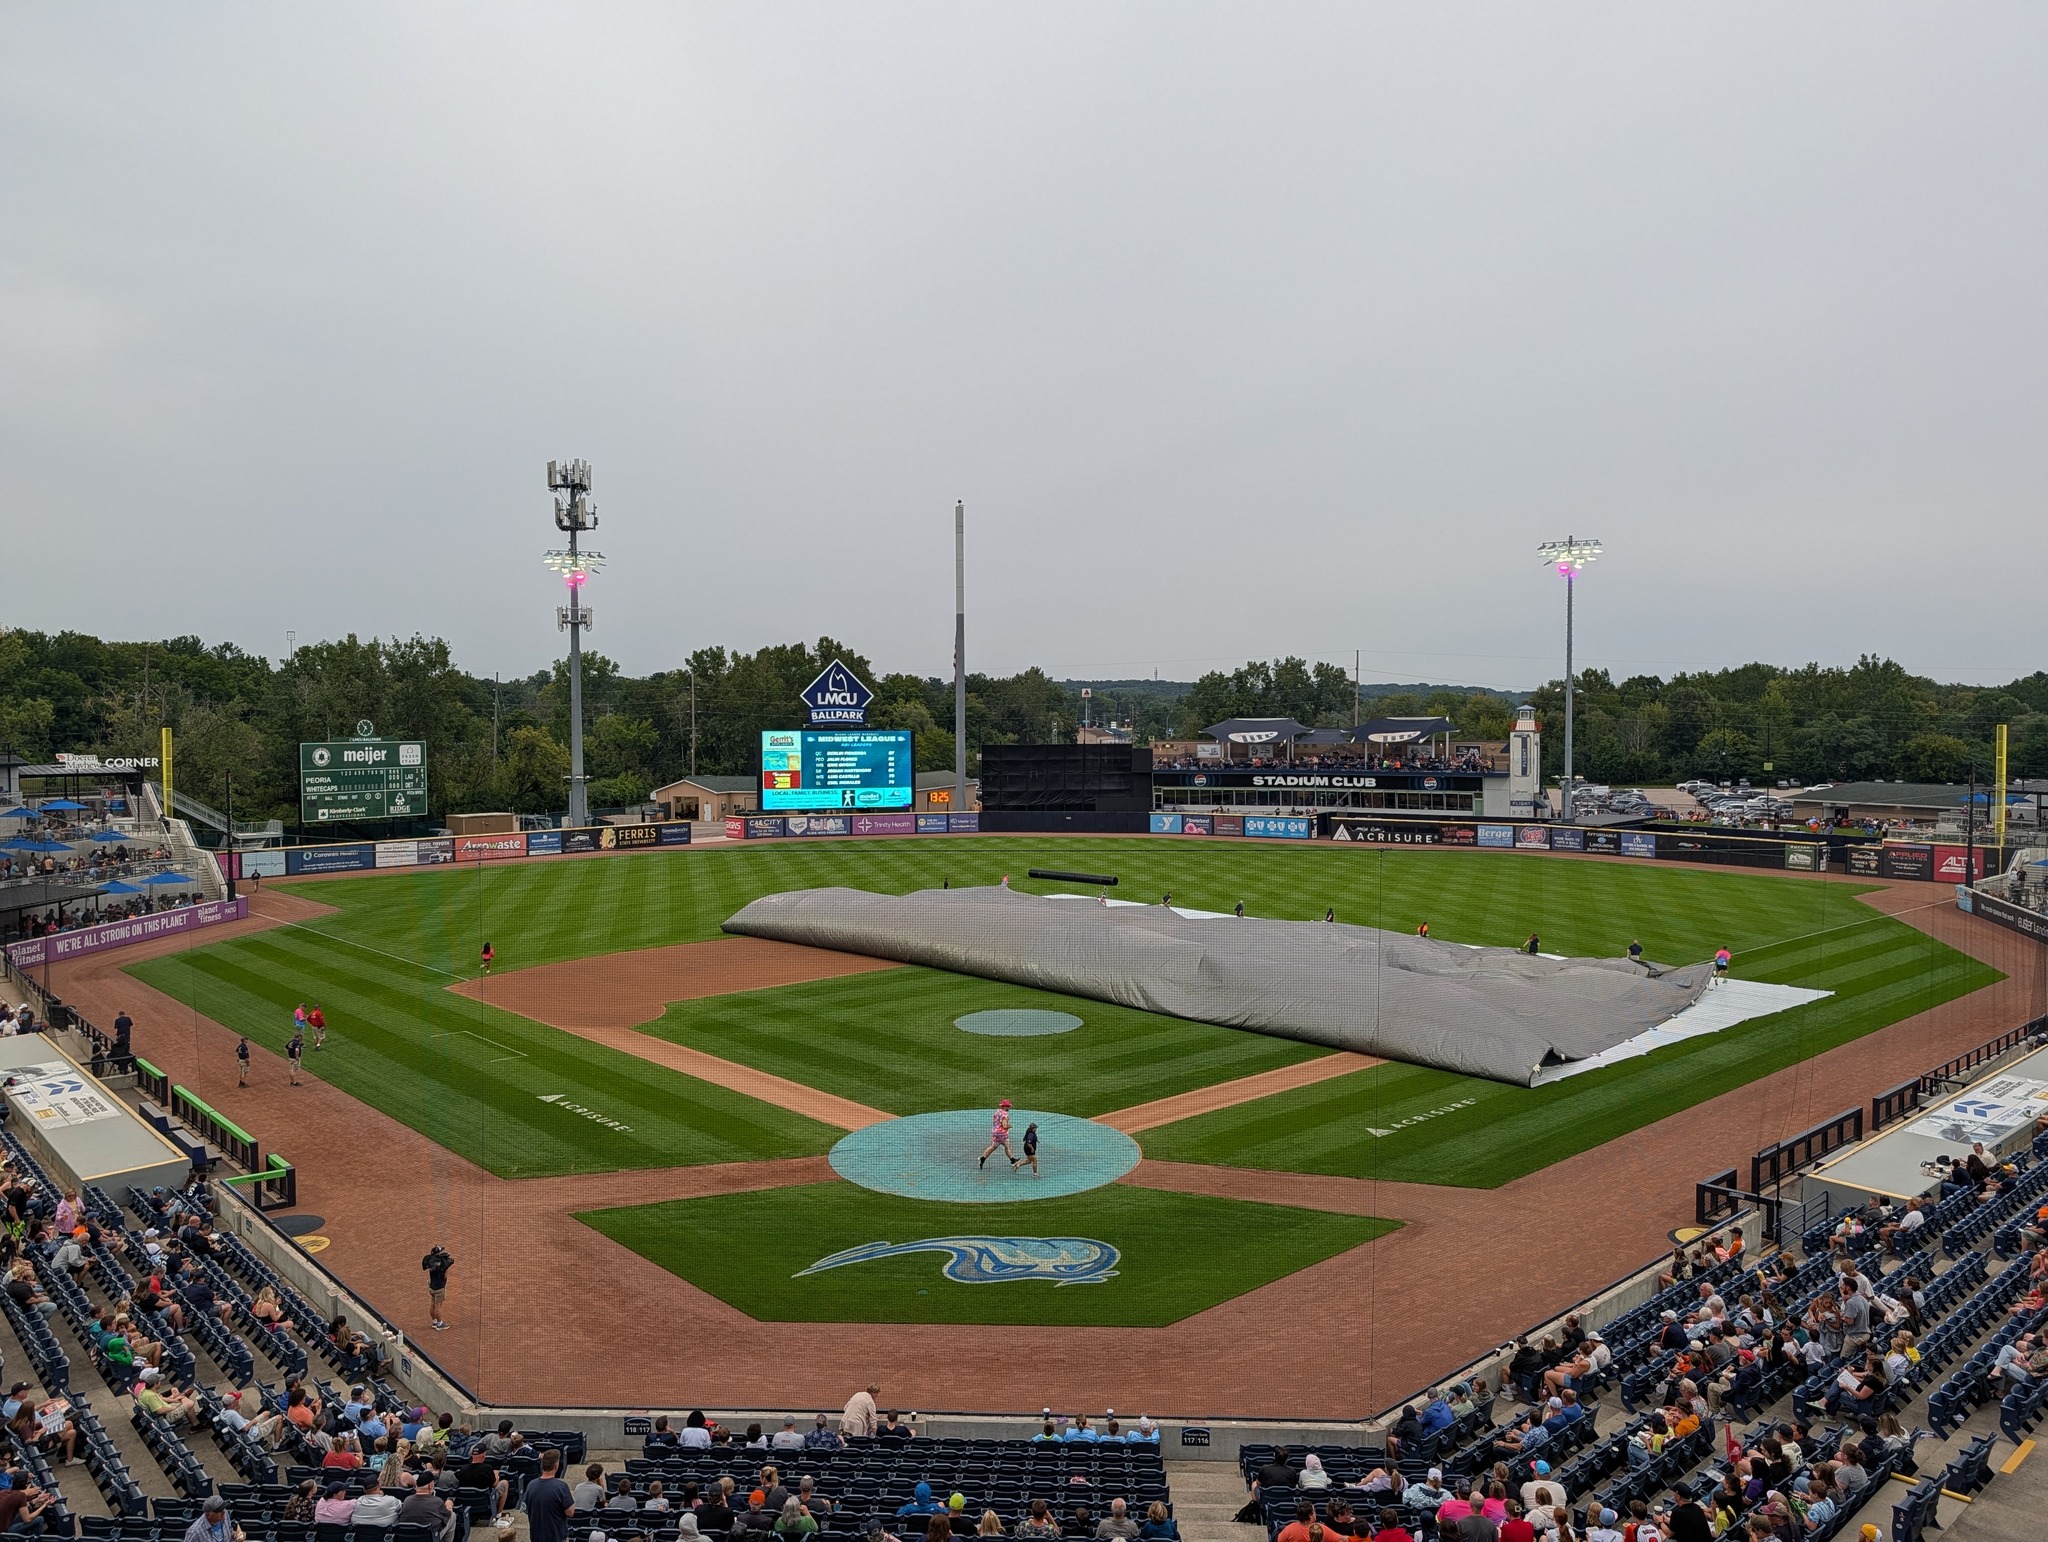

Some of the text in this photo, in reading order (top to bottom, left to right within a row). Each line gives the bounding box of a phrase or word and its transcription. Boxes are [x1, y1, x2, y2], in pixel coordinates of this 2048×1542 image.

[817, 692, 858, 706] LMCU
[811, 711, 864, 720] BALLPARK
[344, 746, 388, 765] meijer
[66, 761, 100, 770] Mayhew
[105, 757, 159, 768] CORNER
[1253, 776, 1377, 787] STADIUM CLUB
[618, 827, 656, 840] FERRIS
[1357, 832, 1433, 843] ACRISURE
[1478, 829, 1512, 838] Berger
[1942, 856, 1975, 867] ALT
[197, 904, 218, 919] planet
[225, 906, 237, 914] PATIO
[200, 912, 221, 924] fitness
[56, 913, 187, 954] WE'RE ALL STRONG ON THIS PLANET
[11, 942, 40, 959] planet
[15, 952, 45, 966] fitness
[555, 1101, 630, 1132] ACRISURE
[1390, 1098, 1476, 1129] ACRISURE
